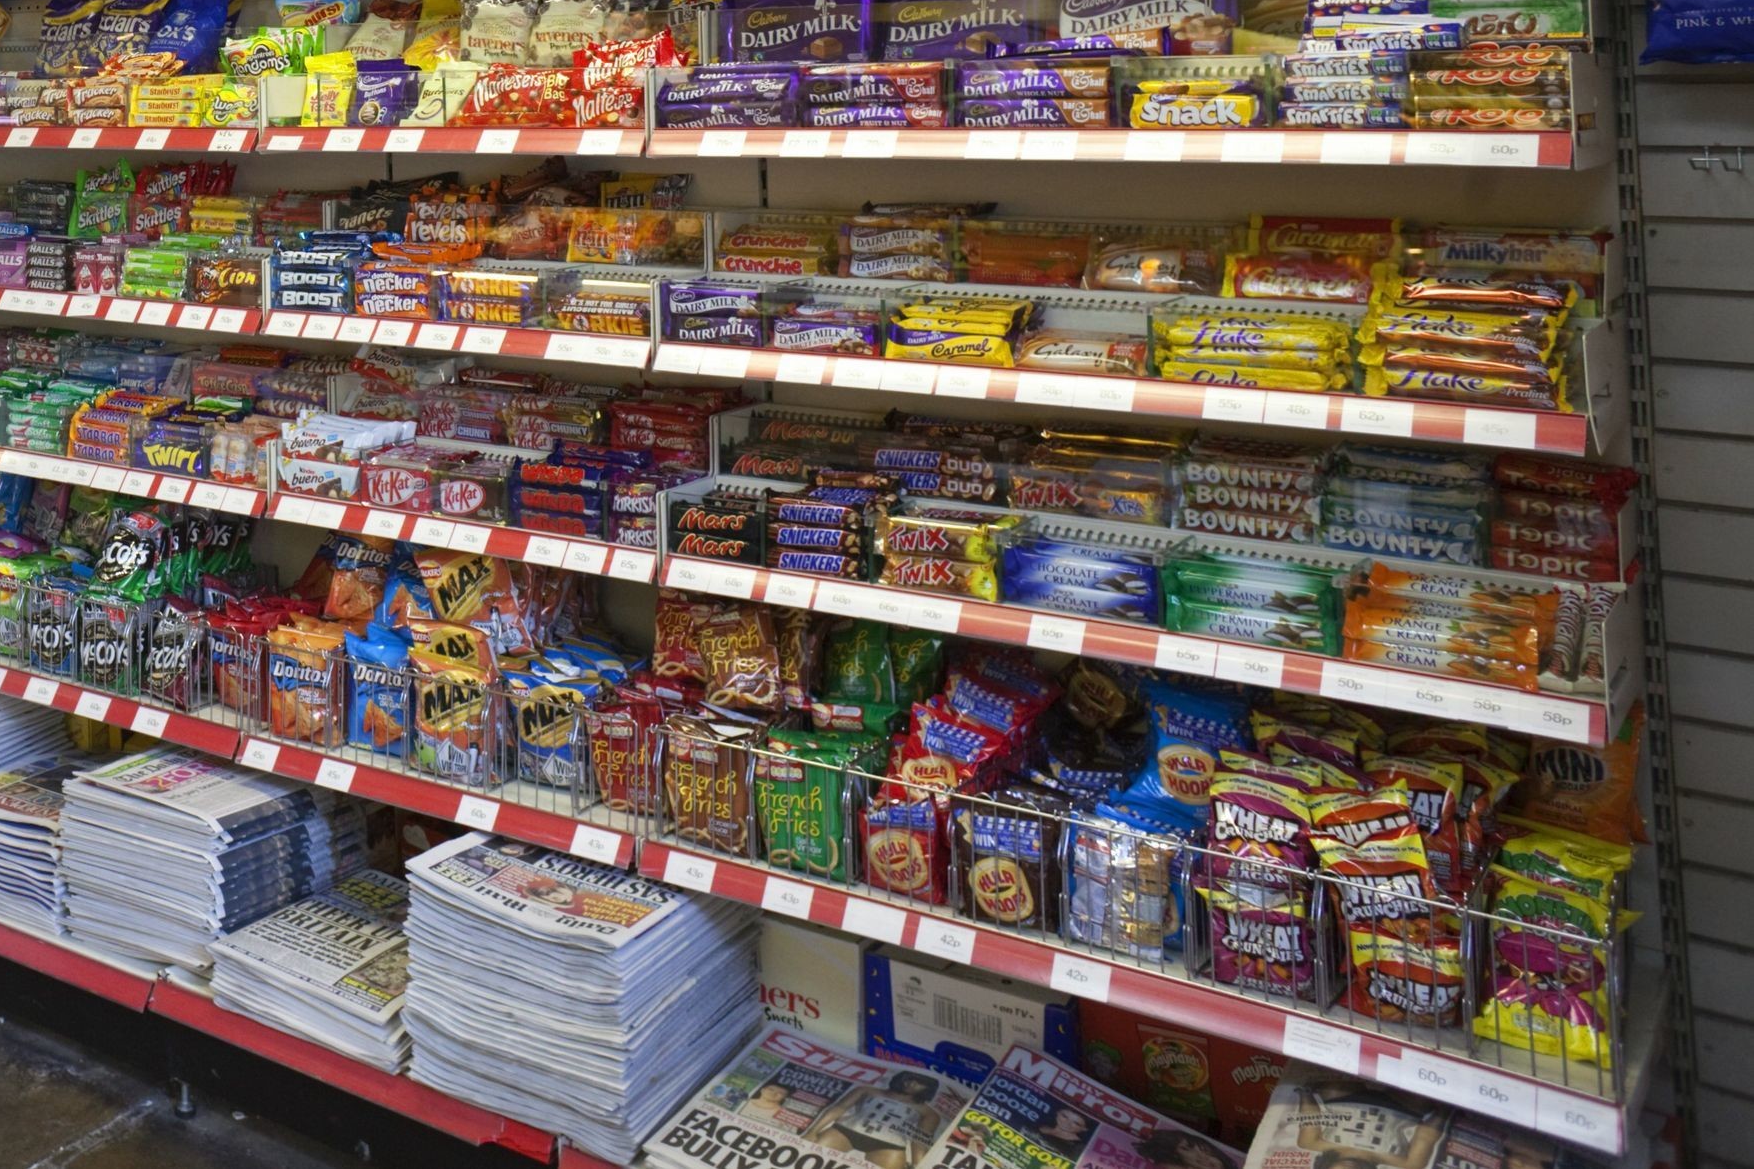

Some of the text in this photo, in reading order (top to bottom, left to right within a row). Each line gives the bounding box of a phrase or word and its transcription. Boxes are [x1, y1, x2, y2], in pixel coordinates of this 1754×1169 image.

[1675, 15, 1710, 29] PINK
[740, 15, 860, 49] DAIRY MILK
[1141, 99, 1241, 126] snack
[1447, 242, 1547, 263] Milkybar
[724, 256, 803, 275] crunchie
[280, 271, 335, 286] BOOST
[931, 338, 992, 358] Caramel
[1389, 369, 1485, 389] Flake
[1358, 410, 1385, 422] 62p
[291, 438, 326, 451] bueno
[948, 459, 982, 473] DUO
[1186, 462, 1294, 490] BOUNTY
[372, 470, 410, 502] KitKat
[676, 507, 745, 531] Mars
[779, 506, 843, 524] SNICKERS
[779, 529, 841, 547] SNICKERS
[1495, 523, 1591, 550] Topic
[437, 556, 491, 612] MAX
[1382, 615, 1442, 631] ORANGE
[939, 934, 962, 950] 42p
[982, 1085, 1040, 1121] booze
[965, 1111, 992, 1128] GO
